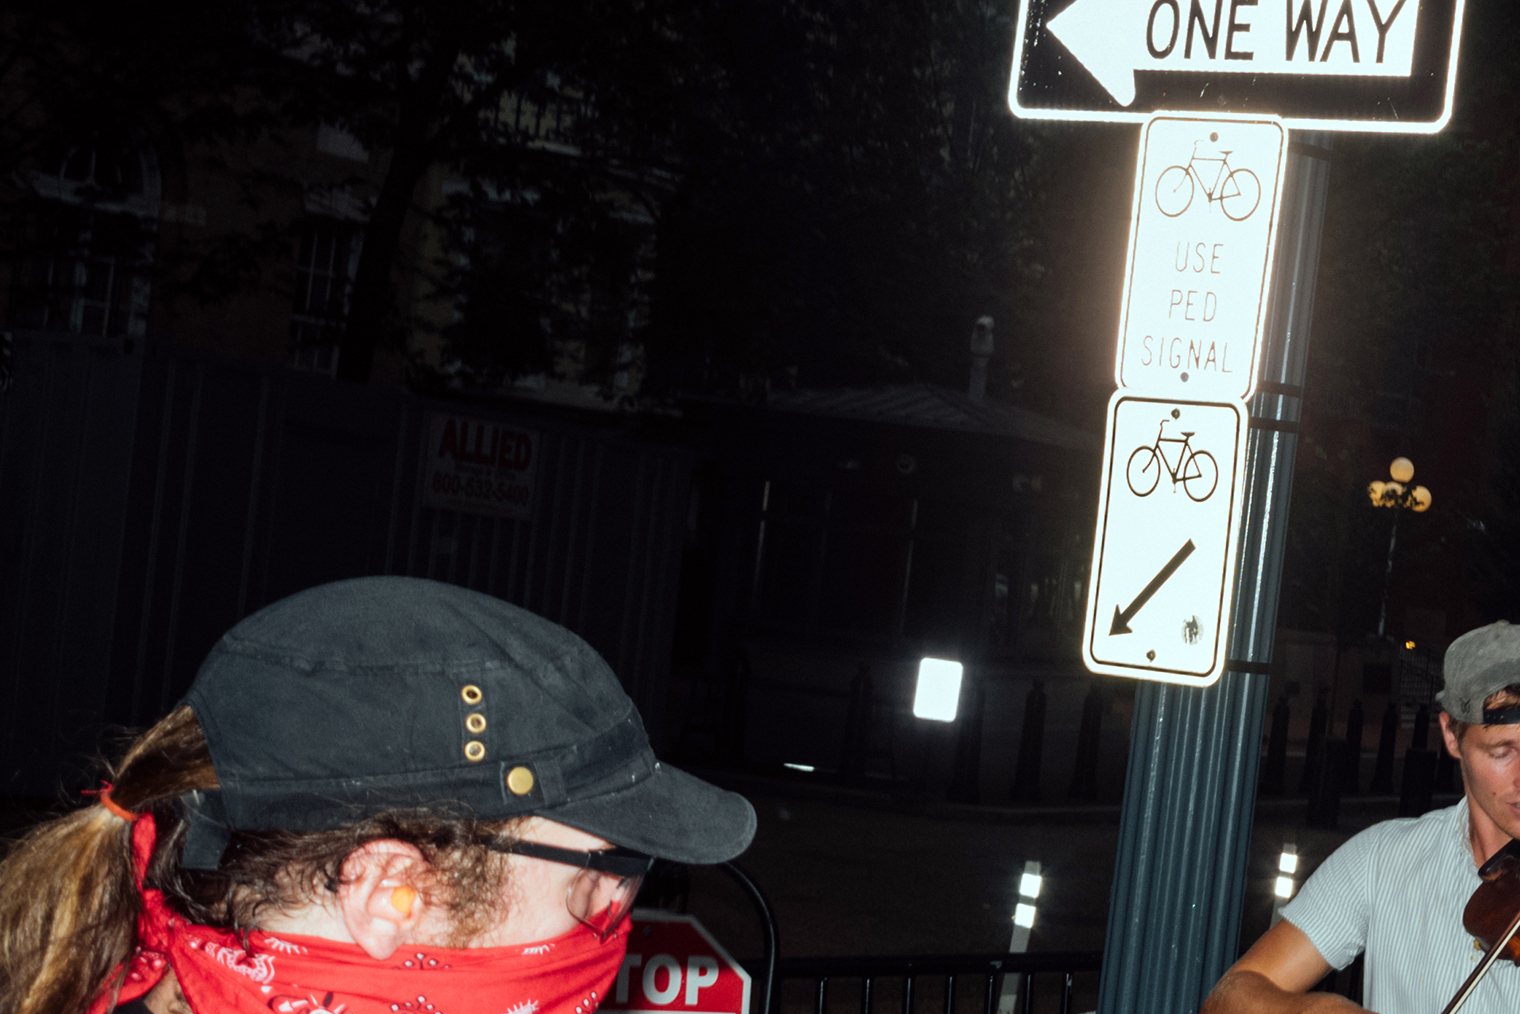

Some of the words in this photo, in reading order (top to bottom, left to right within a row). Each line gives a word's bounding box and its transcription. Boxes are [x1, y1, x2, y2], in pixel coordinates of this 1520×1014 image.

[1145, 0, 1259, 60] ONE
[1285, 0, 1407, 64] WAY
[1174, 241, 1224, 275] USE
[1168, 289, 1218, 323] PED
[1140, 335, 1233, 374] SIGNAL
[438, 419, 532, 472] ALLIED
[615, 952, 720, 1006] TOP
